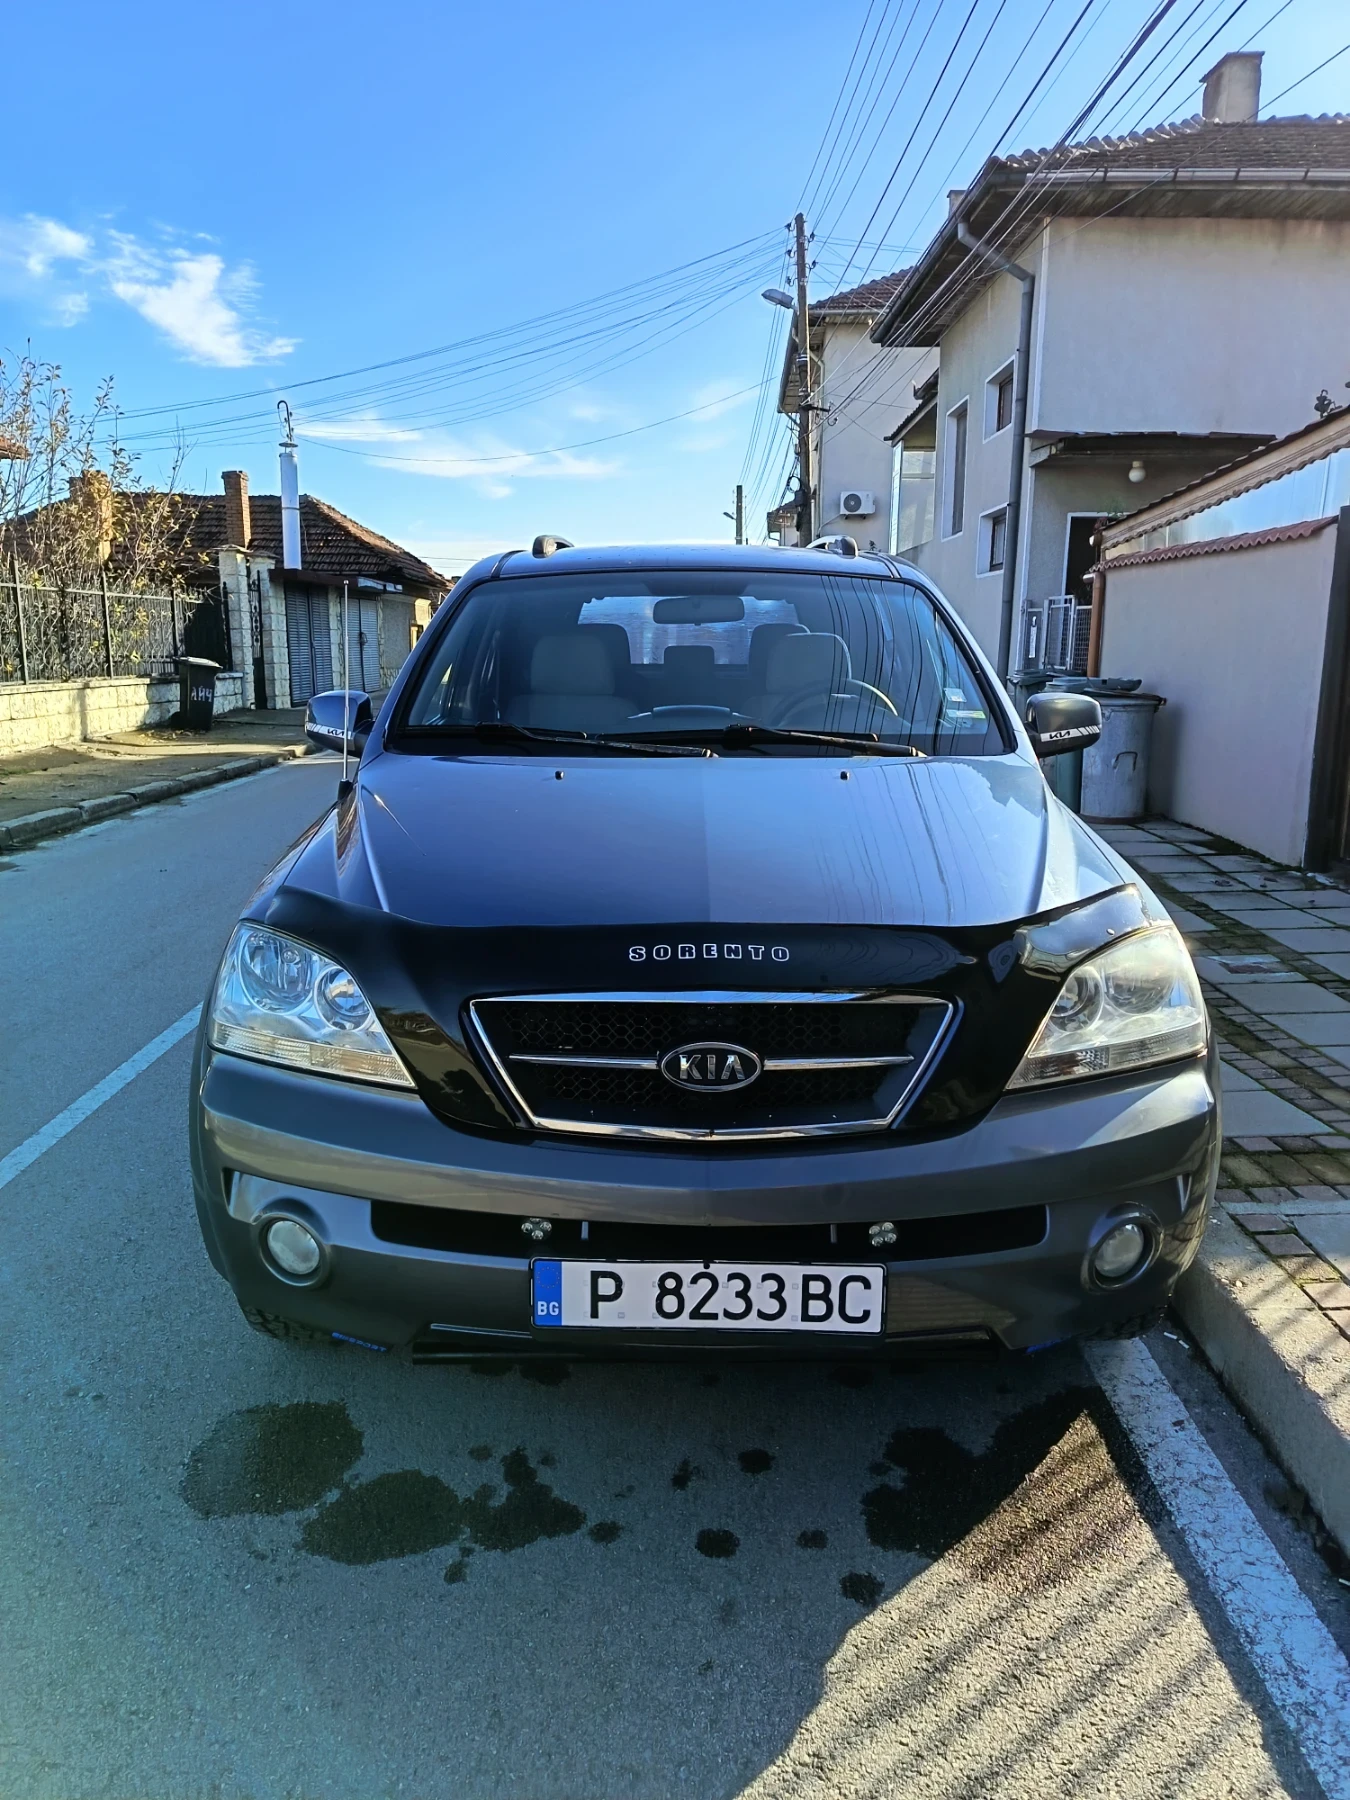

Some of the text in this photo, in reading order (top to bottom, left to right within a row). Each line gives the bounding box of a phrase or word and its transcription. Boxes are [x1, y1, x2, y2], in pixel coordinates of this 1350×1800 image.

[1049, 730, 1071, 740] KIA
[629, 944, 789, 961] SORENTO
[679, 1054, 746, 1080] KIA
[590, 1270, 872, 1324] P 8233 BC
[537, 1301, 559, 1316] BG
